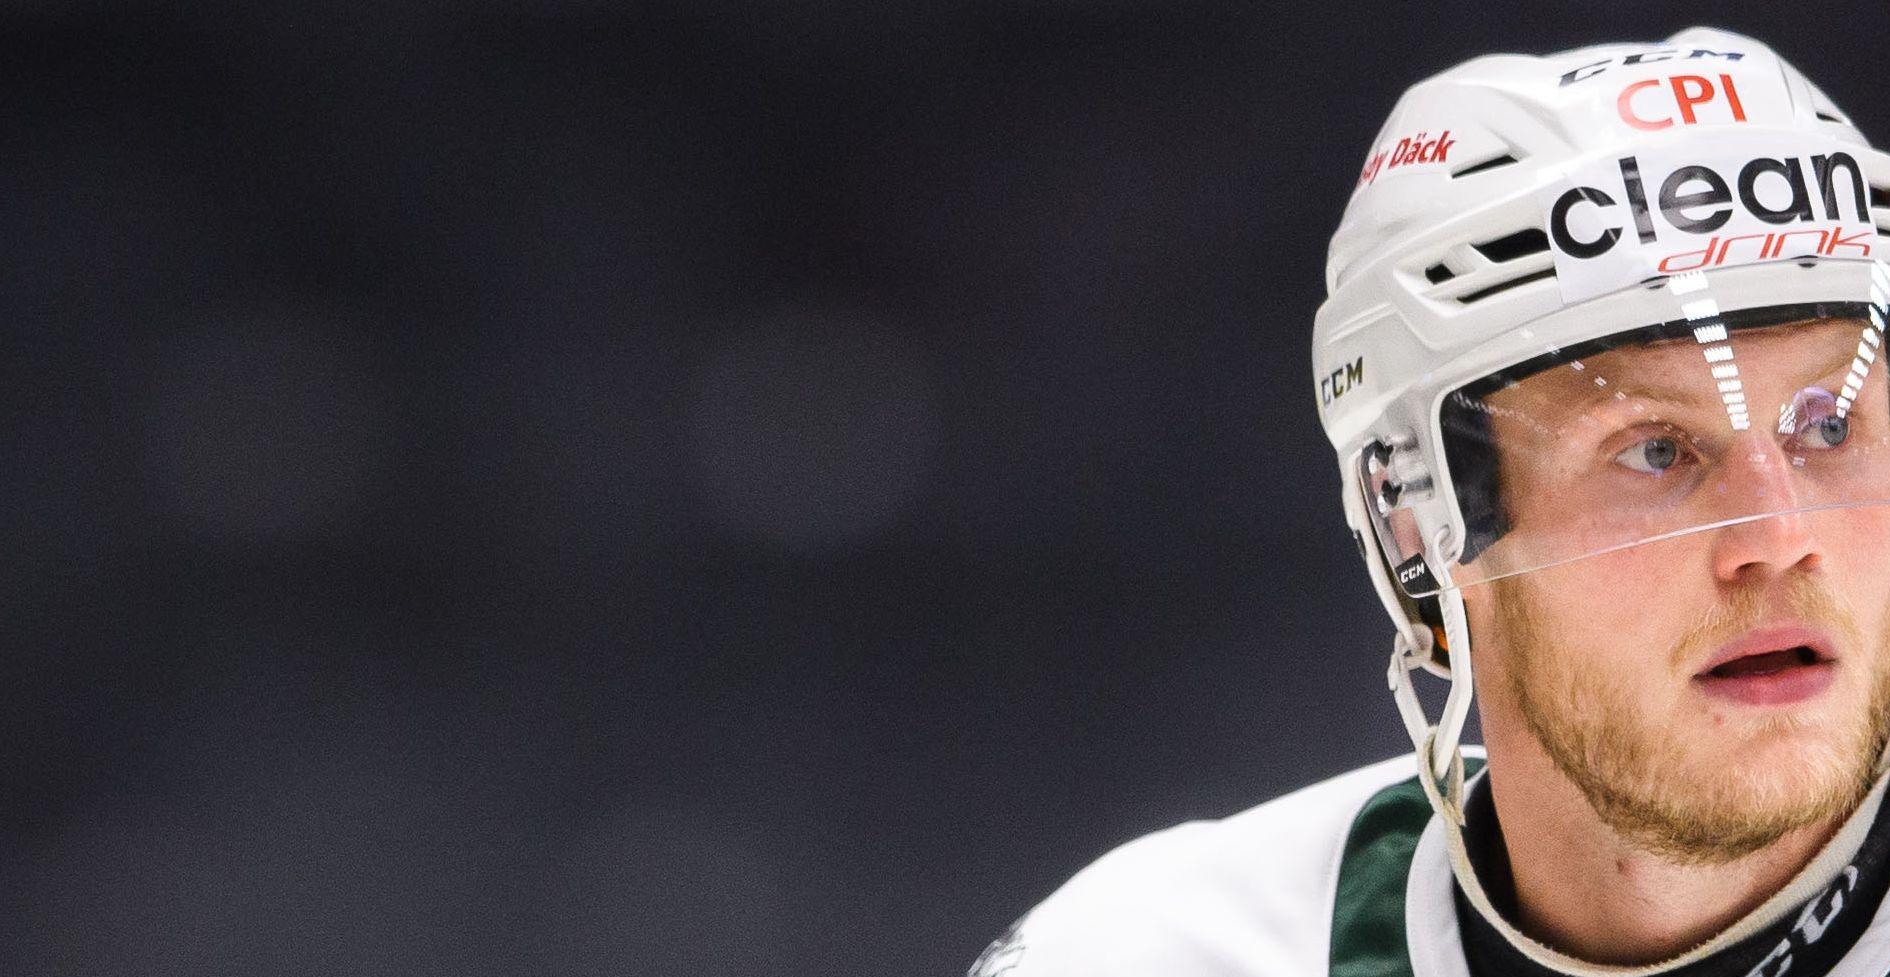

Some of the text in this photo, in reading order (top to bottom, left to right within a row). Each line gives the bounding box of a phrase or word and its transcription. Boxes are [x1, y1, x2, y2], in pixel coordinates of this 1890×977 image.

[1558, 48, 1745, 88] CCM
[1616, 73, 1748, 132] CPI
[1388, 130, 1456, 170] Däck
[1549, 151, 1871, 259] clean
[1657, 226, 1875, 273] drink
[1321, 356, 1363, 409] CCM
[1400, 562, 1425, 584] CCM
